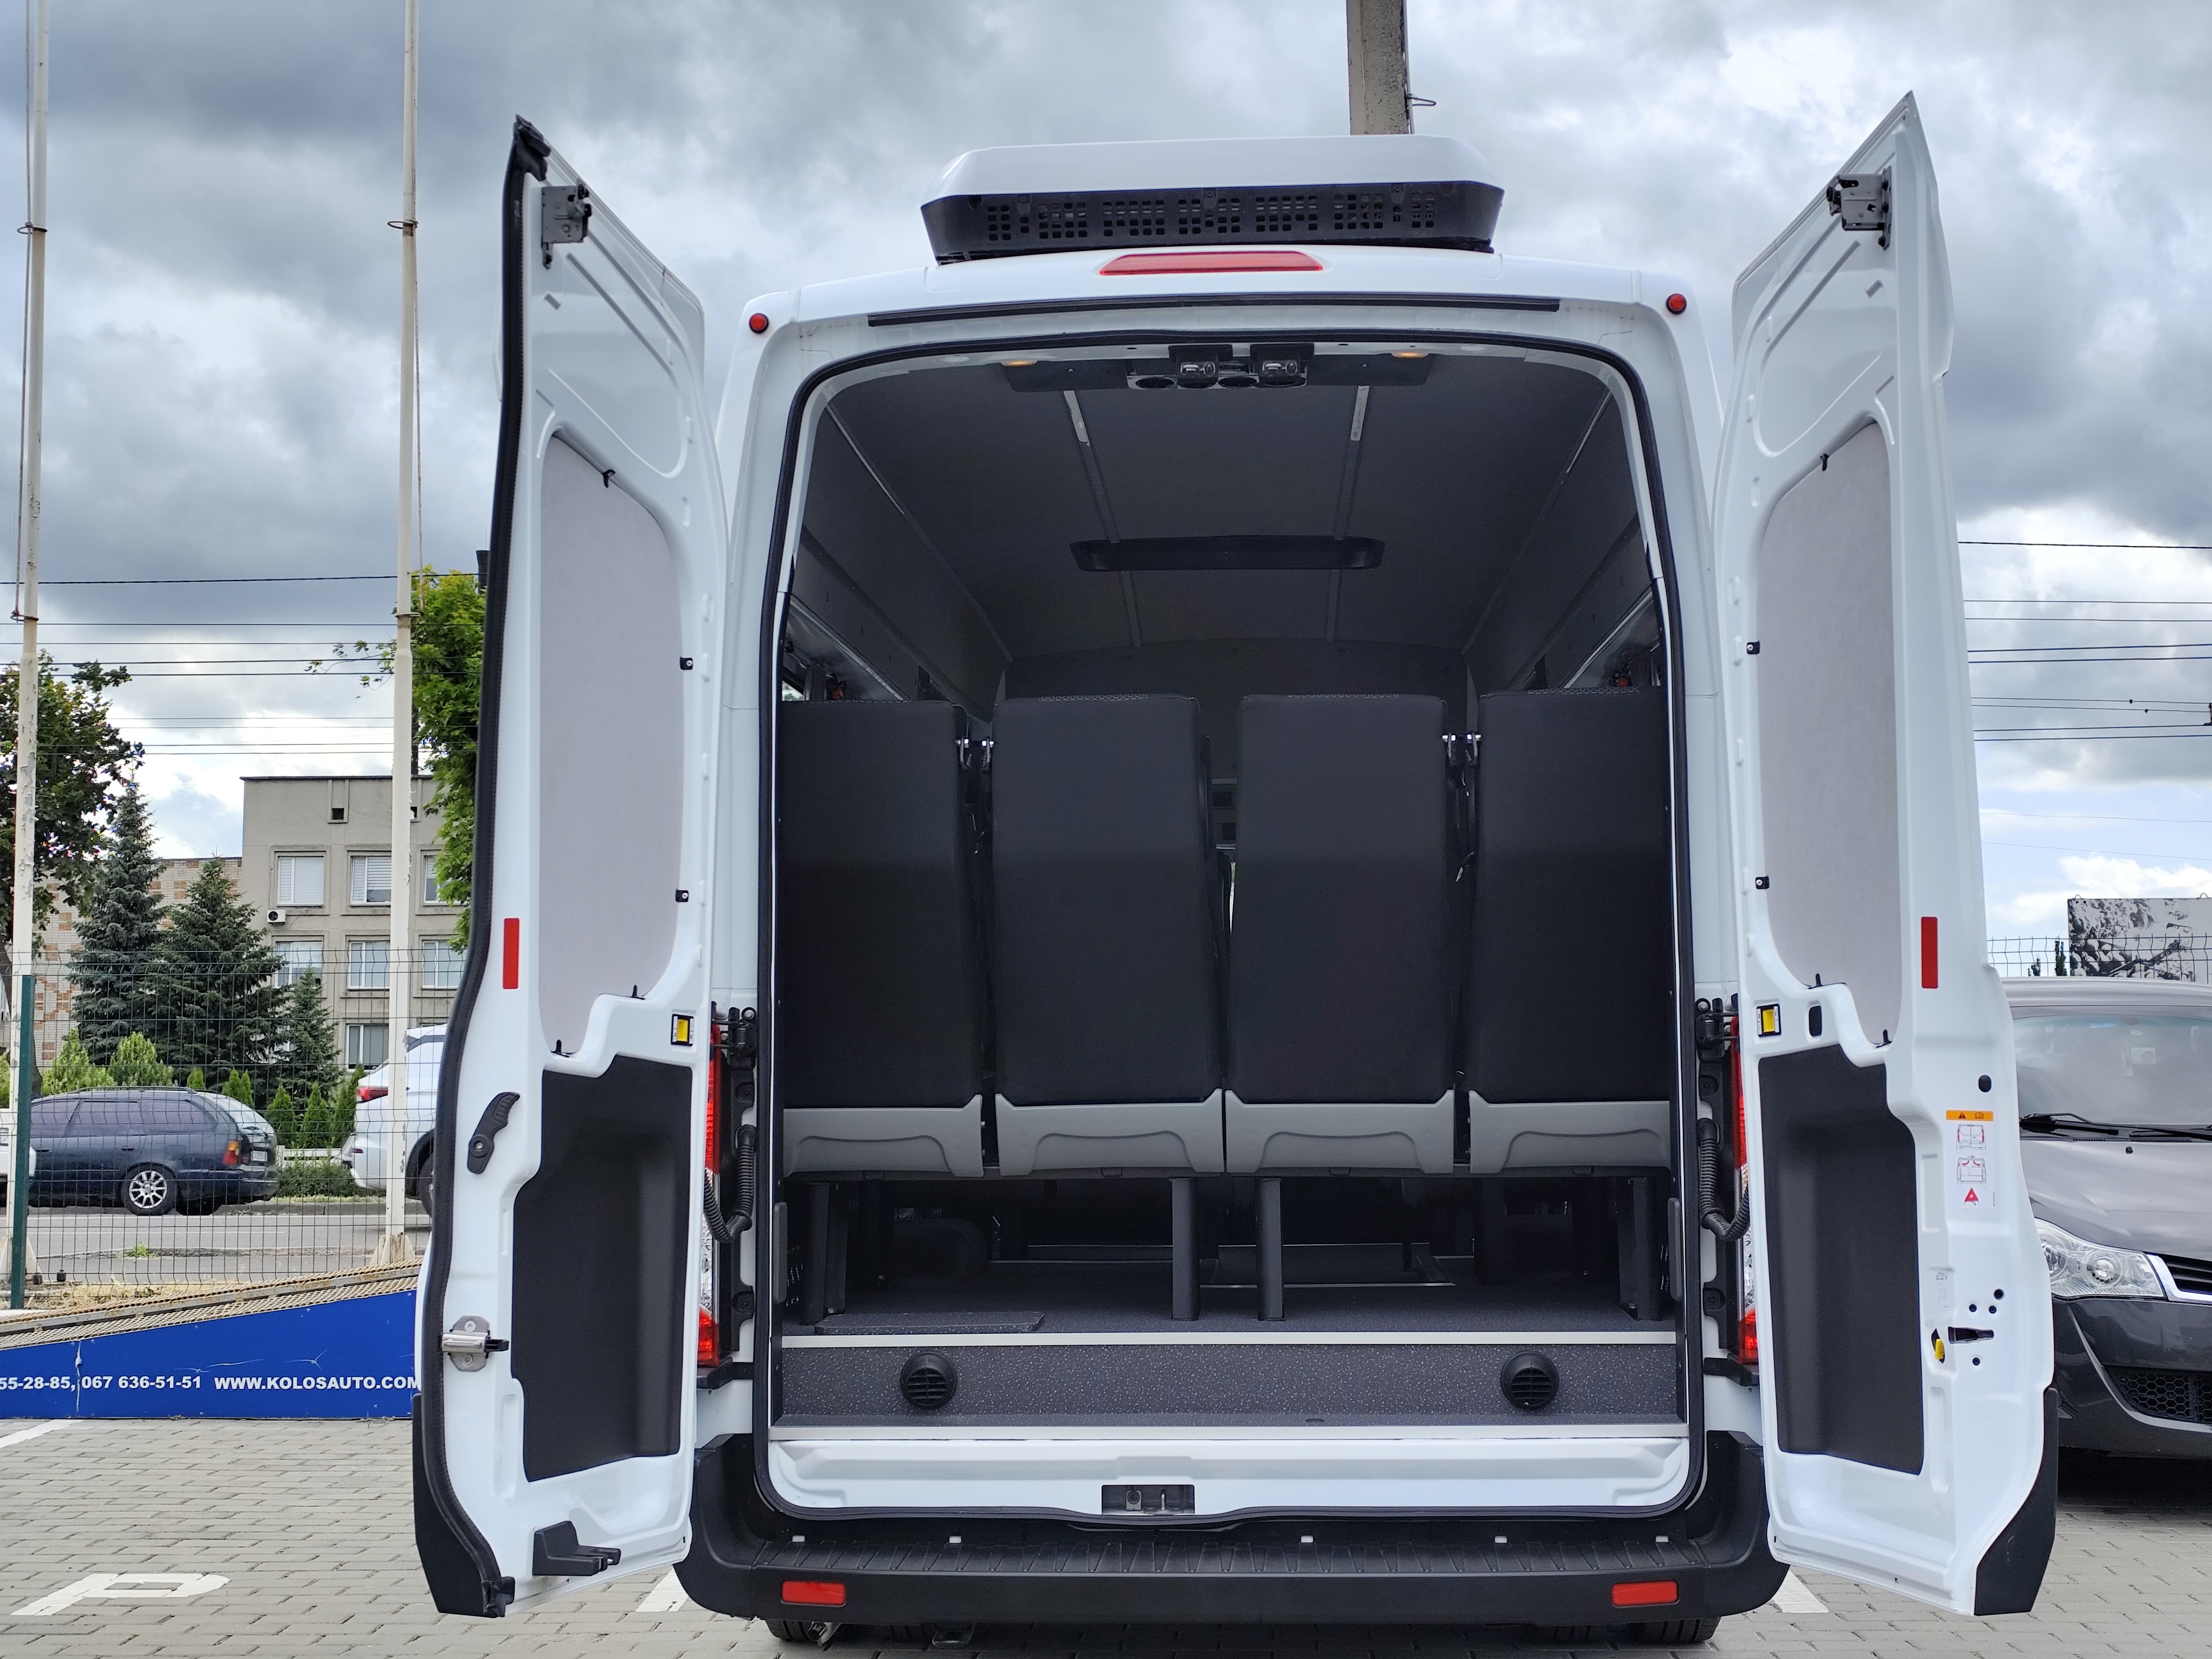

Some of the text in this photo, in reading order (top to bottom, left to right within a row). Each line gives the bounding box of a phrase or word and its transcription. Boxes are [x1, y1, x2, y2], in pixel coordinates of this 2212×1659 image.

[0, 1376, 418, 1392] 55-28-85, 067 636-51-51 WWW.KOLOSAUTO.COM
